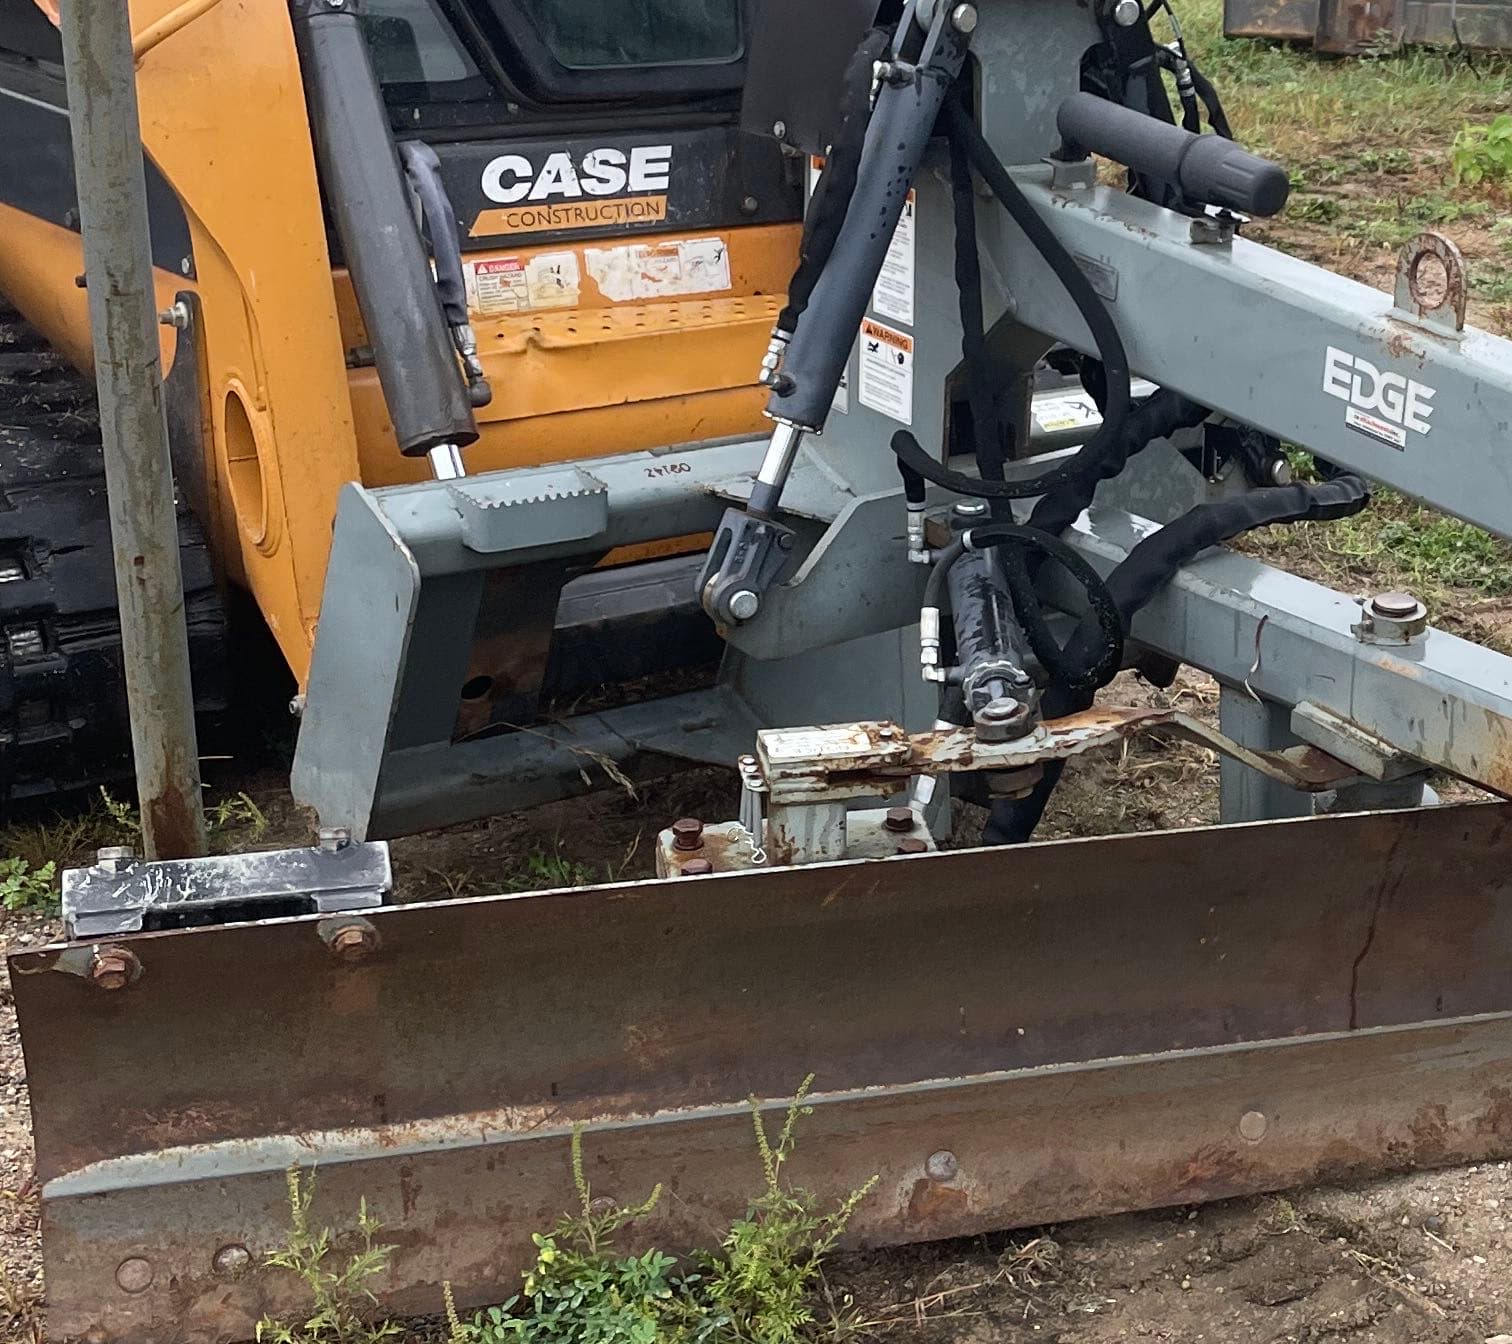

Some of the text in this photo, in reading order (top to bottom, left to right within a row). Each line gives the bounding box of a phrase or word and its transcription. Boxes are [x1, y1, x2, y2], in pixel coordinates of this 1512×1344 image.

[481, 144, 672, 204] CASE
[506, 201, 660, 229] CONSTRUCTION
[872, 326, 909, 350] WARNING
[1323, 345, 1437, 435] EDGE
